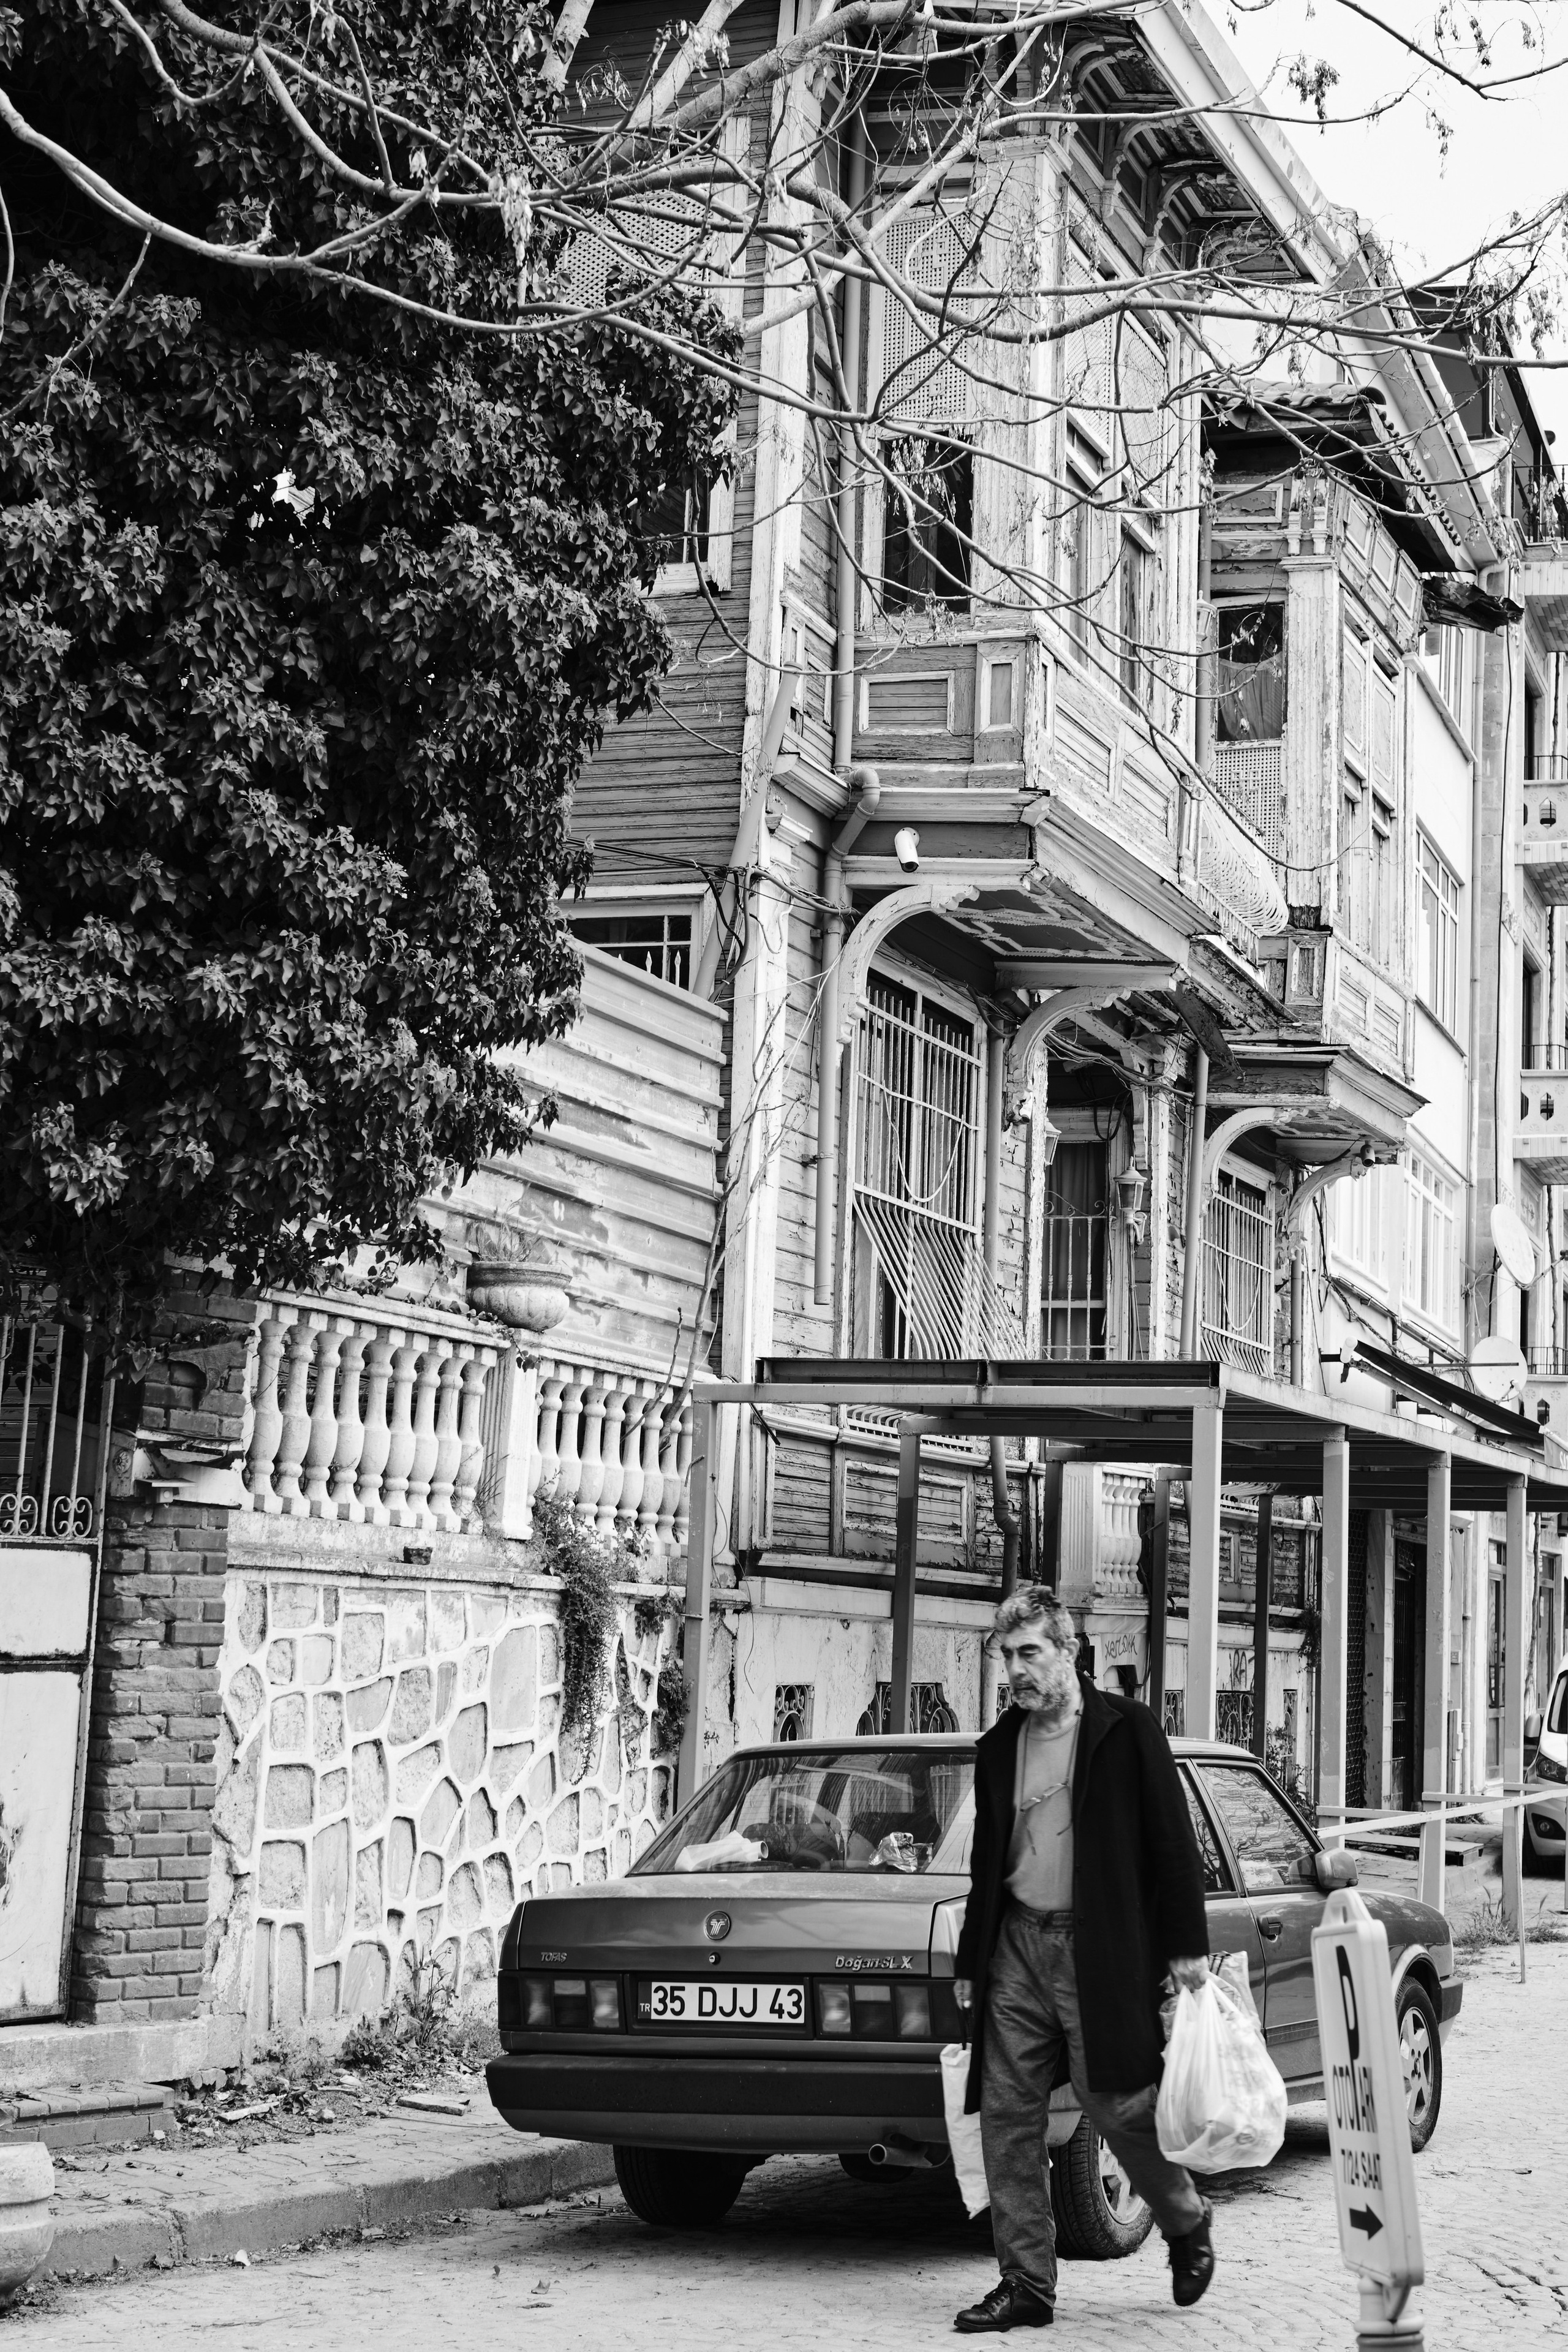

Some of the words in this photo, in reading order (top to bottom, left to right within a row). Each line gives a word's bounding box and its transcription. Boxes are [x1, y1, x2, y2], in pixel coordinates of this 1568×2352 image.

[541, 1951, 567, 1963] TOFAŞ
[835, 1955, 880, 1971] Doğan
[639, 2003, 650, 2012] TR
[653, 1985, 685, 2016] 35
[698, 1986, 758, 2018] DJJ
[769, 1988, 802, 2020] 43
